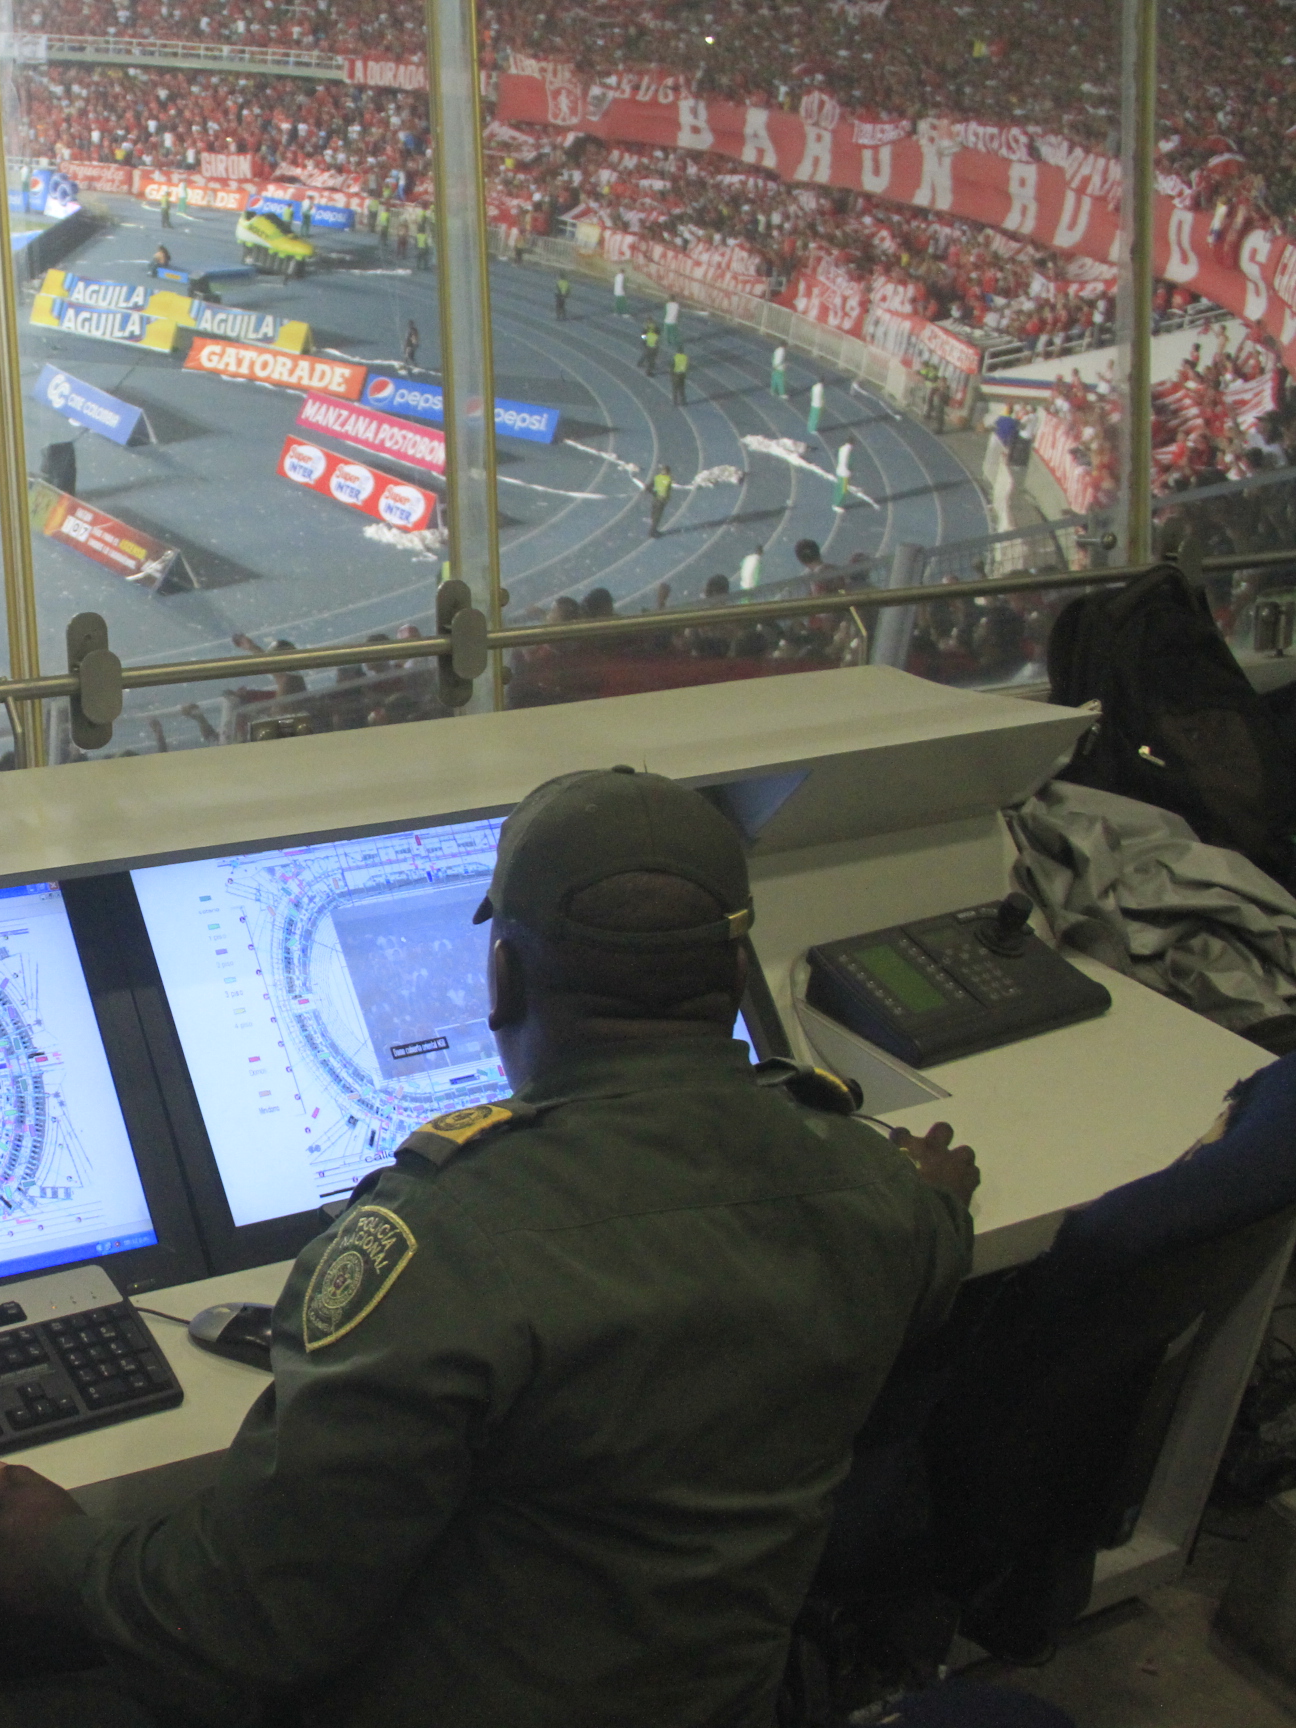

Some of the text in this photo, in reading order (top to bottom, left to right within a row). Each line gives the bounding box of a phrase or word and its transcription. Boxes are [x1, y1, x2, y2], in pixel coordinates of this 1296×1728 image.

[344, 59, 365, 84] LA
[68, 280, 146, 309] AGUILA
[62, 307, 144, 339] AGUILA
[197, 308, 277, 341] AGUILA
[199, 344, 352, 393] GATORADE
[392, 386, 443, 411] peps
[494, 407, 548, 432] pepsi
[300, 398, 446, 467] MANZANA POSTOBON
[288, 461, 315, 481] INTER
[334, 480, 363, 501] INTER
[383, 501, 413, 523] INTER
[364, 1149, 395, 1163] calle
[339, 1230, 389, 1275] NACIONAL
